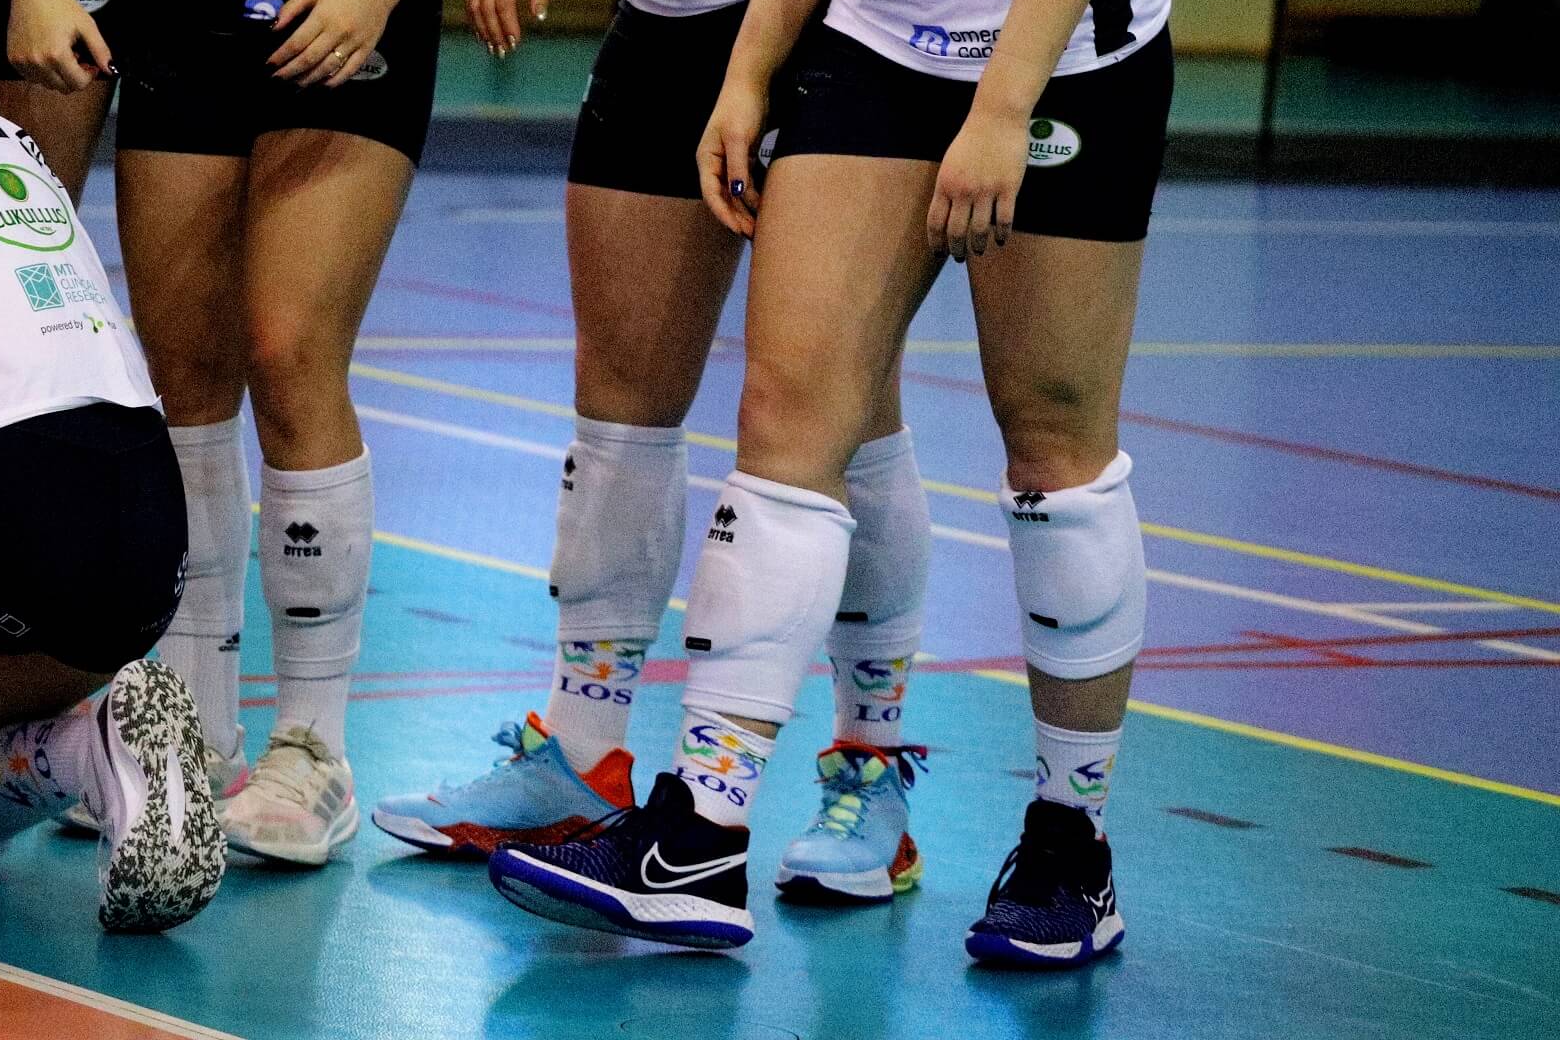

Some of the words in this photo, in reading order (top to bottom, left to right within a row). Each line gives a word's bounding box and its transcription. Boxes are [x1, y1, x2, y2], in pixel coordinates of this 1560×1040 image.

[1030, 142, 1072, 157] ULLUS
[40, 321, 74, 335] powered
[73, 319, 84, 330] by
[559, 675, 634, 705] LOS
[854, 703, 902, 722] LO
[674, 765, 748, 807] LOS
